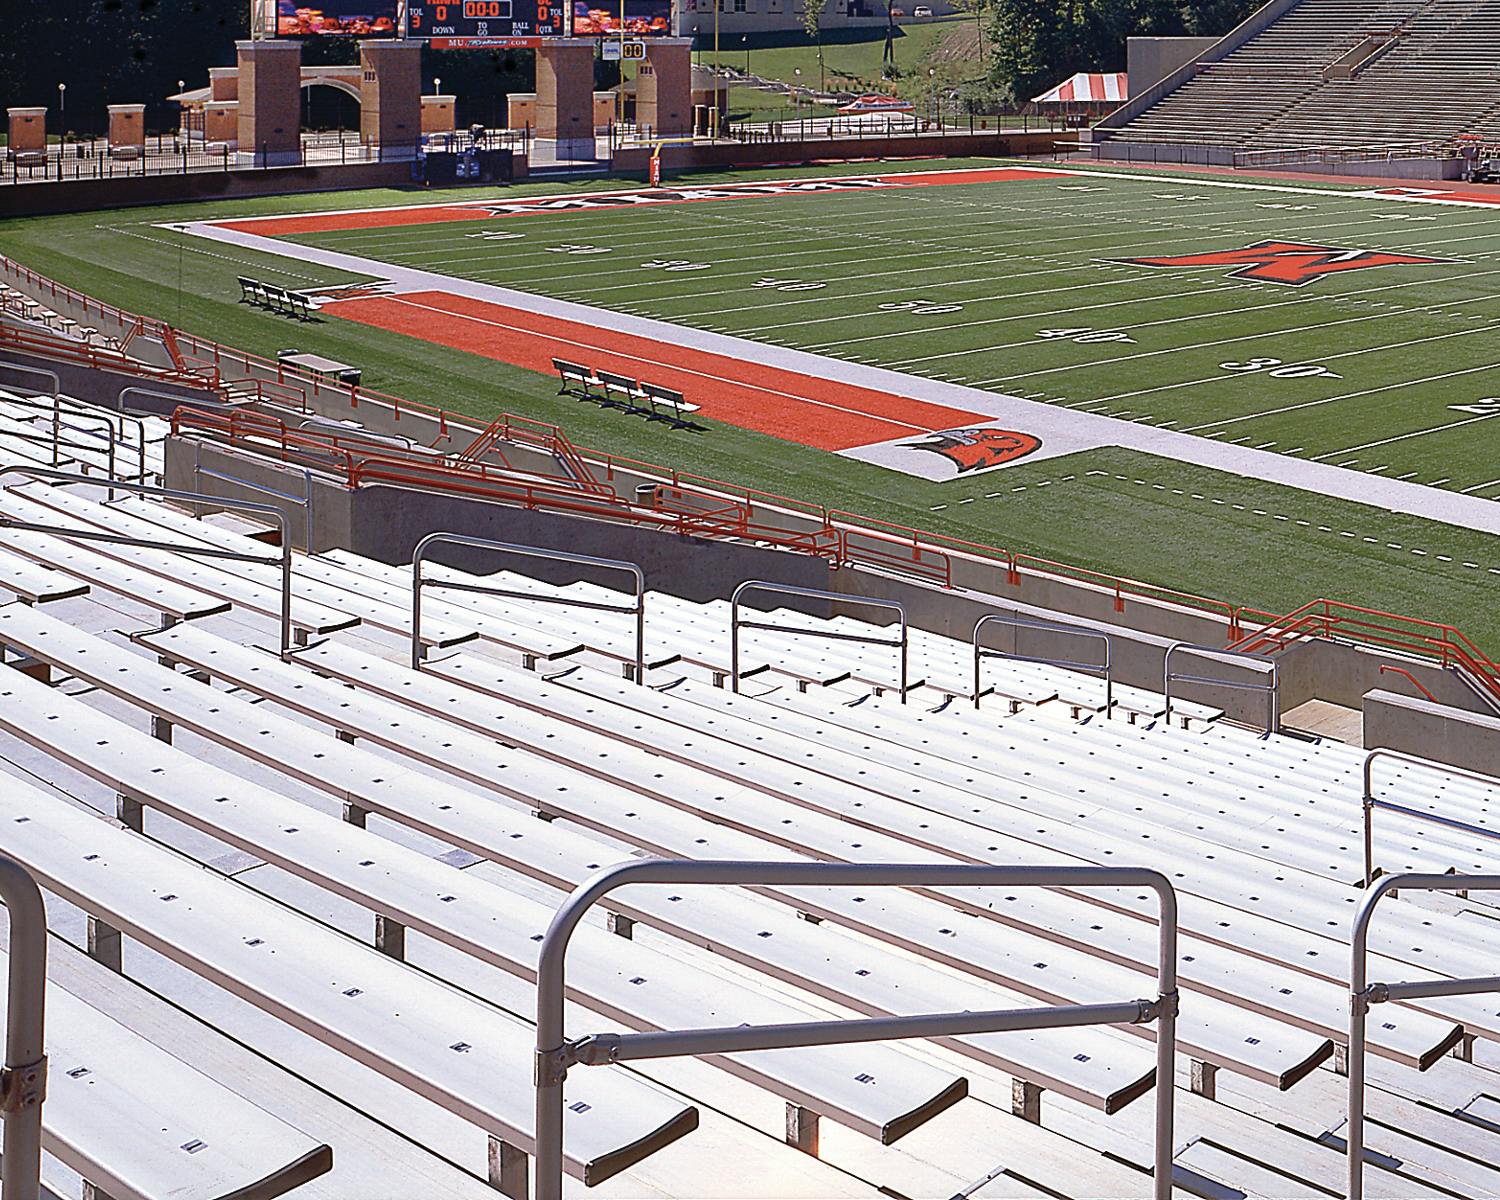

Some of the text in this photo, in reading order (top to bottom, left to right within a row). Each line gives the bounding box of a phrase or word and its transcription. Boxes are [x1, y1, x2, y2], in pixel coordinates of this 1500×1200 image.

[409, 8, 423, 16] TOL
[436, 5, 447, 21] 0
[538, 6, 547, 21] 0
[550, 8, 562, 16] TOL
[412, 16, 420, 28] 3
[553, 16, 560, 28] 3
[432, 26, 455, 34] DOWN
[539, 26, 552, 34] QTR
[624, 44, 642, 58] 00
[878, 300, 964, 315] 50
[1035, 327, 1128, 344] 40
[1219, 357, 1327, 379] 30
